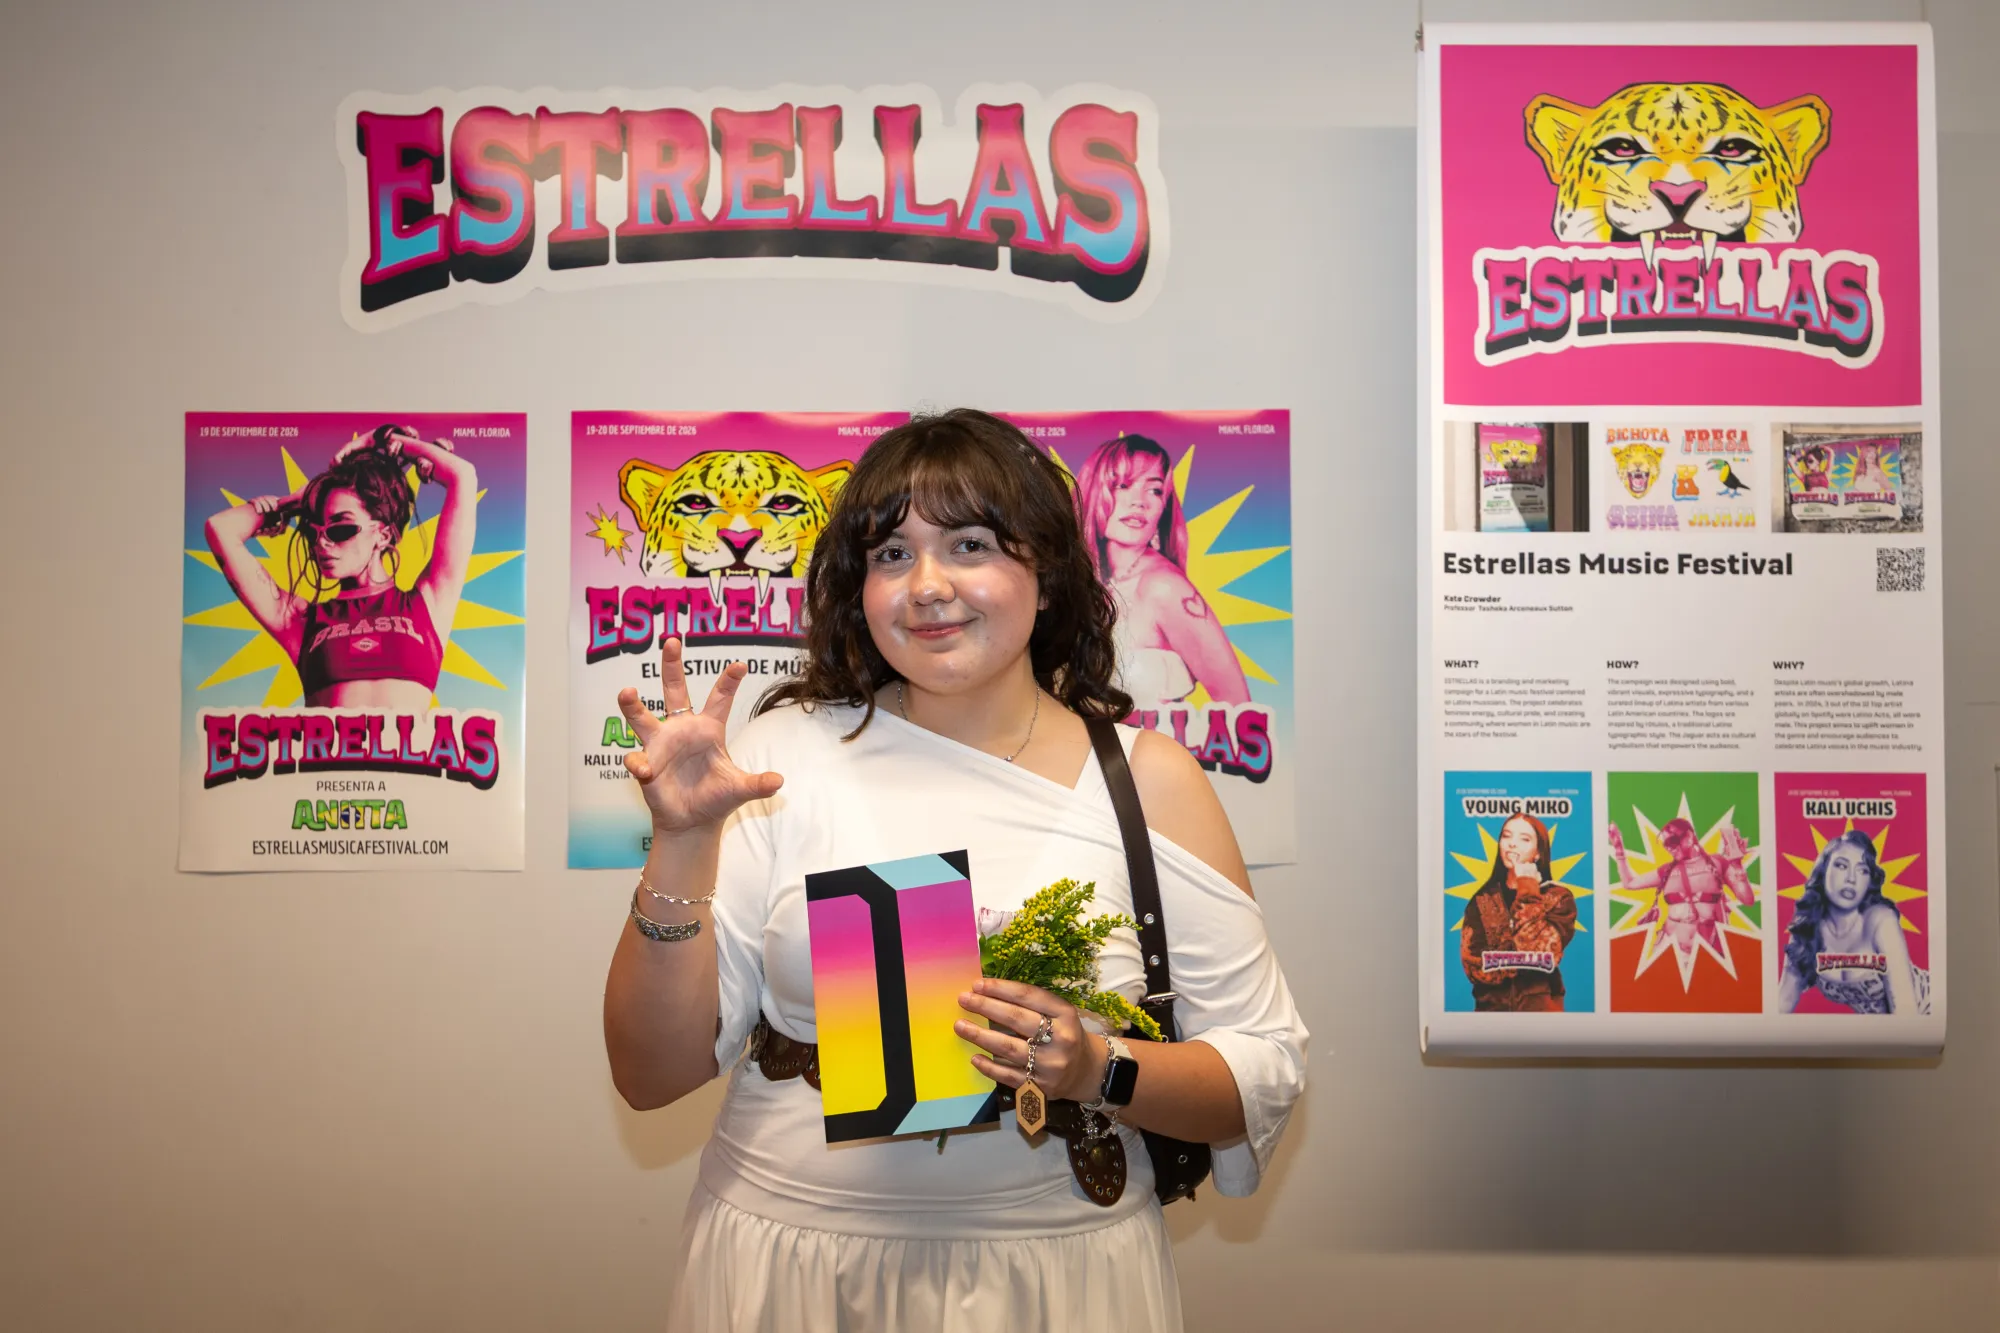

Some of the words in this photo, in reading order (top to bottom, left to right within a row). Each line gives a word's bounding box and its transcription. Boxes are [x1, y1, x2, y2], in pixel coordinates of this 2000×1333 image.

[356, 102, 1150, 312] ESTRELLAS
[1483, 257, 1873, 357] ESTRELLAS
[200, 427, 208, 437] 19
[210, 427, 220, 437] DE
[222, 427, 267, 437] SEPTIEMBRE
[269, 427, 278, 437] DE
[280, 427, 298, 437] 2026
[453, 428, 478, 438] MIAMI,
[479, 428, 510, 438] FLORIDA
[586, 425, 607, 435] 19-20
[609, 425, 618, 435] DE
[620, 425, 665, 435] SEPTIEMBRE
[667, 425, 676, 435] DE
[678, 425, 697, 435] 2026
[838, 426, 862, 437] MIAMI,
[1218, 425, 1242, 435] MIAMI,
[1244, 425, 1275, 435] FLORIDA
[1606, 428, 1670, 444] BICHOTA
[1681, 429, 1752, 454] FRESA
[1444, 552, 1570, 574] Estrellas
[1580, 552, 1670, 575] Music
[1678, 552, 1794, 576] Festival
[586, 585, 808, 664] ESTRELL
[309, 615, 424, 653] BRASIL
[642, 663, 660, 678] EL
[749, 658, 768, 674] DE
[1444, 660, 1479, 668] WHAT?
[1607, 660, 1639, 669] HOW?
[1773, 661, 1804, 669] WHY?
[203, 713, 499, 790] ESTRELLAS
[584, 754, 610, 766] KALI
[600, 770, 630, 780] KENIA
[316, 781, 376, 792] PRESENTA
[378, 781, 386, 792] A
[1466, 800, 1521, 814] YOUNG
[1526, 800, 1569, 814] MIKO
[1806, 801, 1841, 816] KALI
[1846, 801, 1894, 816] UCHIS
[292, 799, 408, 831] ANITTA
[252, 840, 448, 855] ESTRELLASMUSICAFESTIVAL.COM
